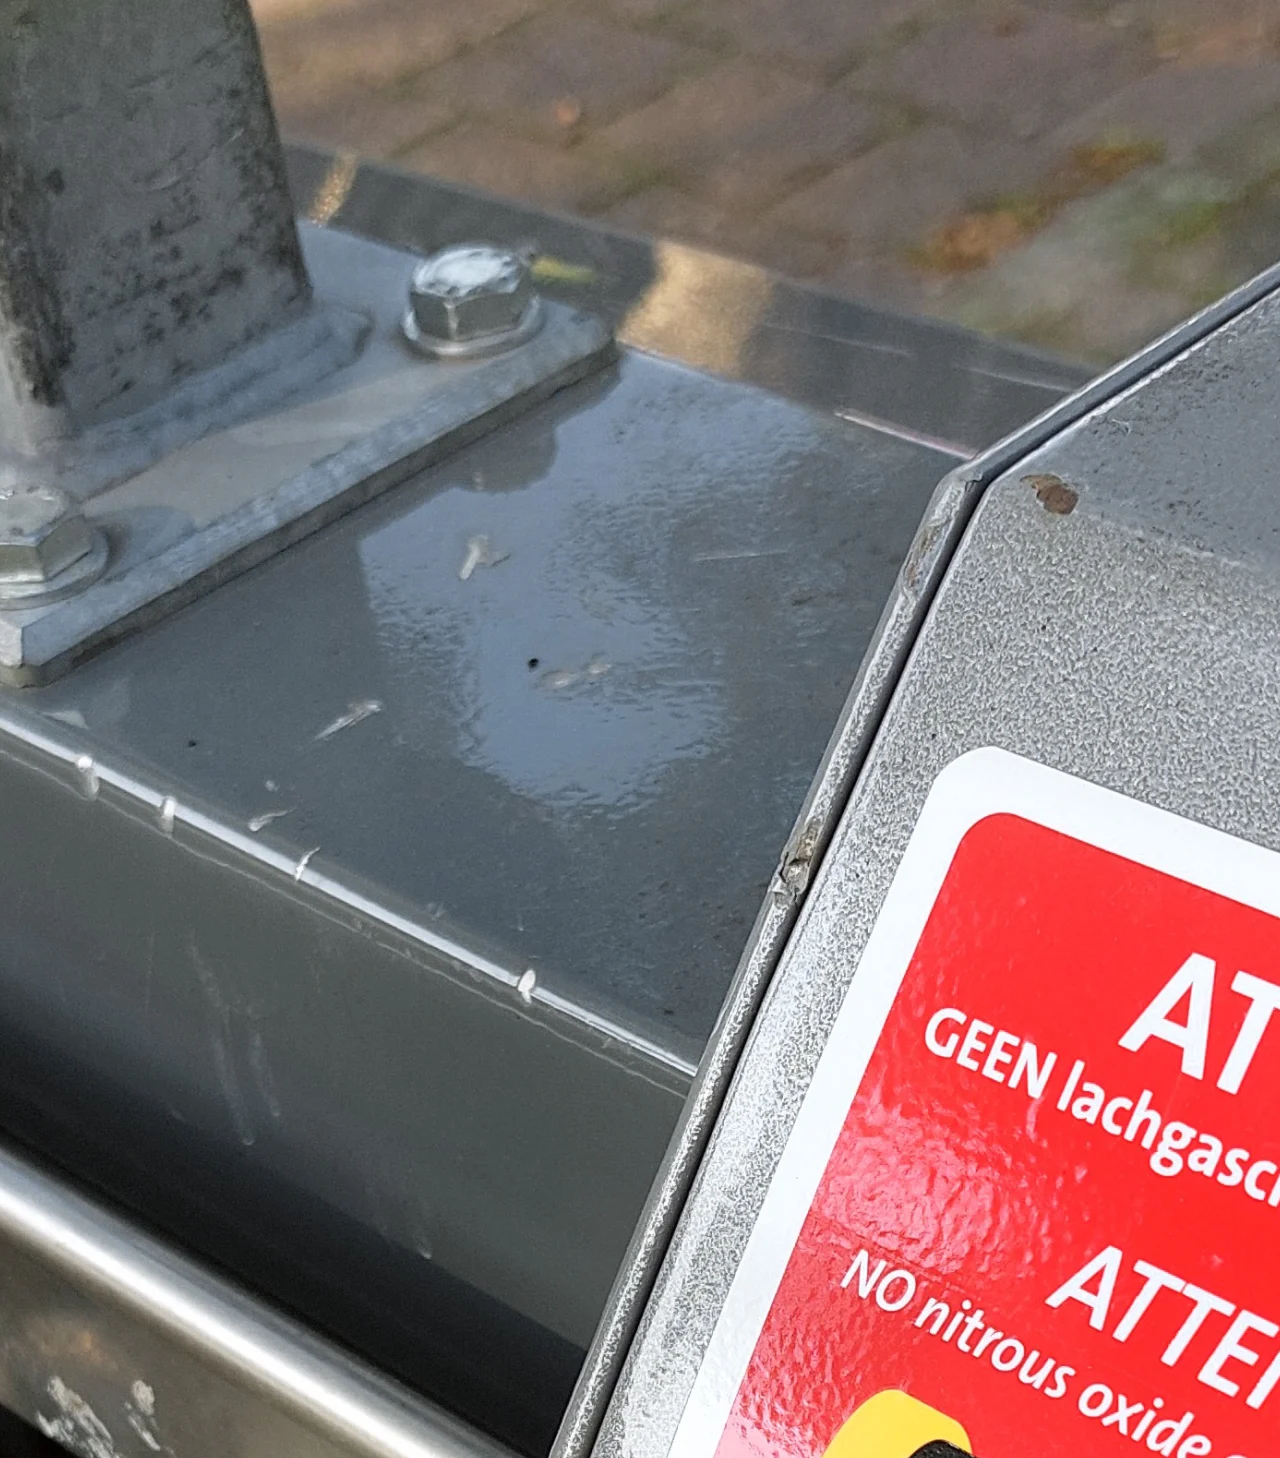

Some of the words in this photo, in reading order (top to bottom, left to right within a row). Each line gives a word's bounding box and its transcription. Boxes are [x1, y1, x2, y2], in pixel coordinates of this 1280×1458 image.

[923, 1006, 1058, 1100] GEEN
[839, 1248, 917, 1313] NO
[914, 1296, 1077, 1399] nitrous
